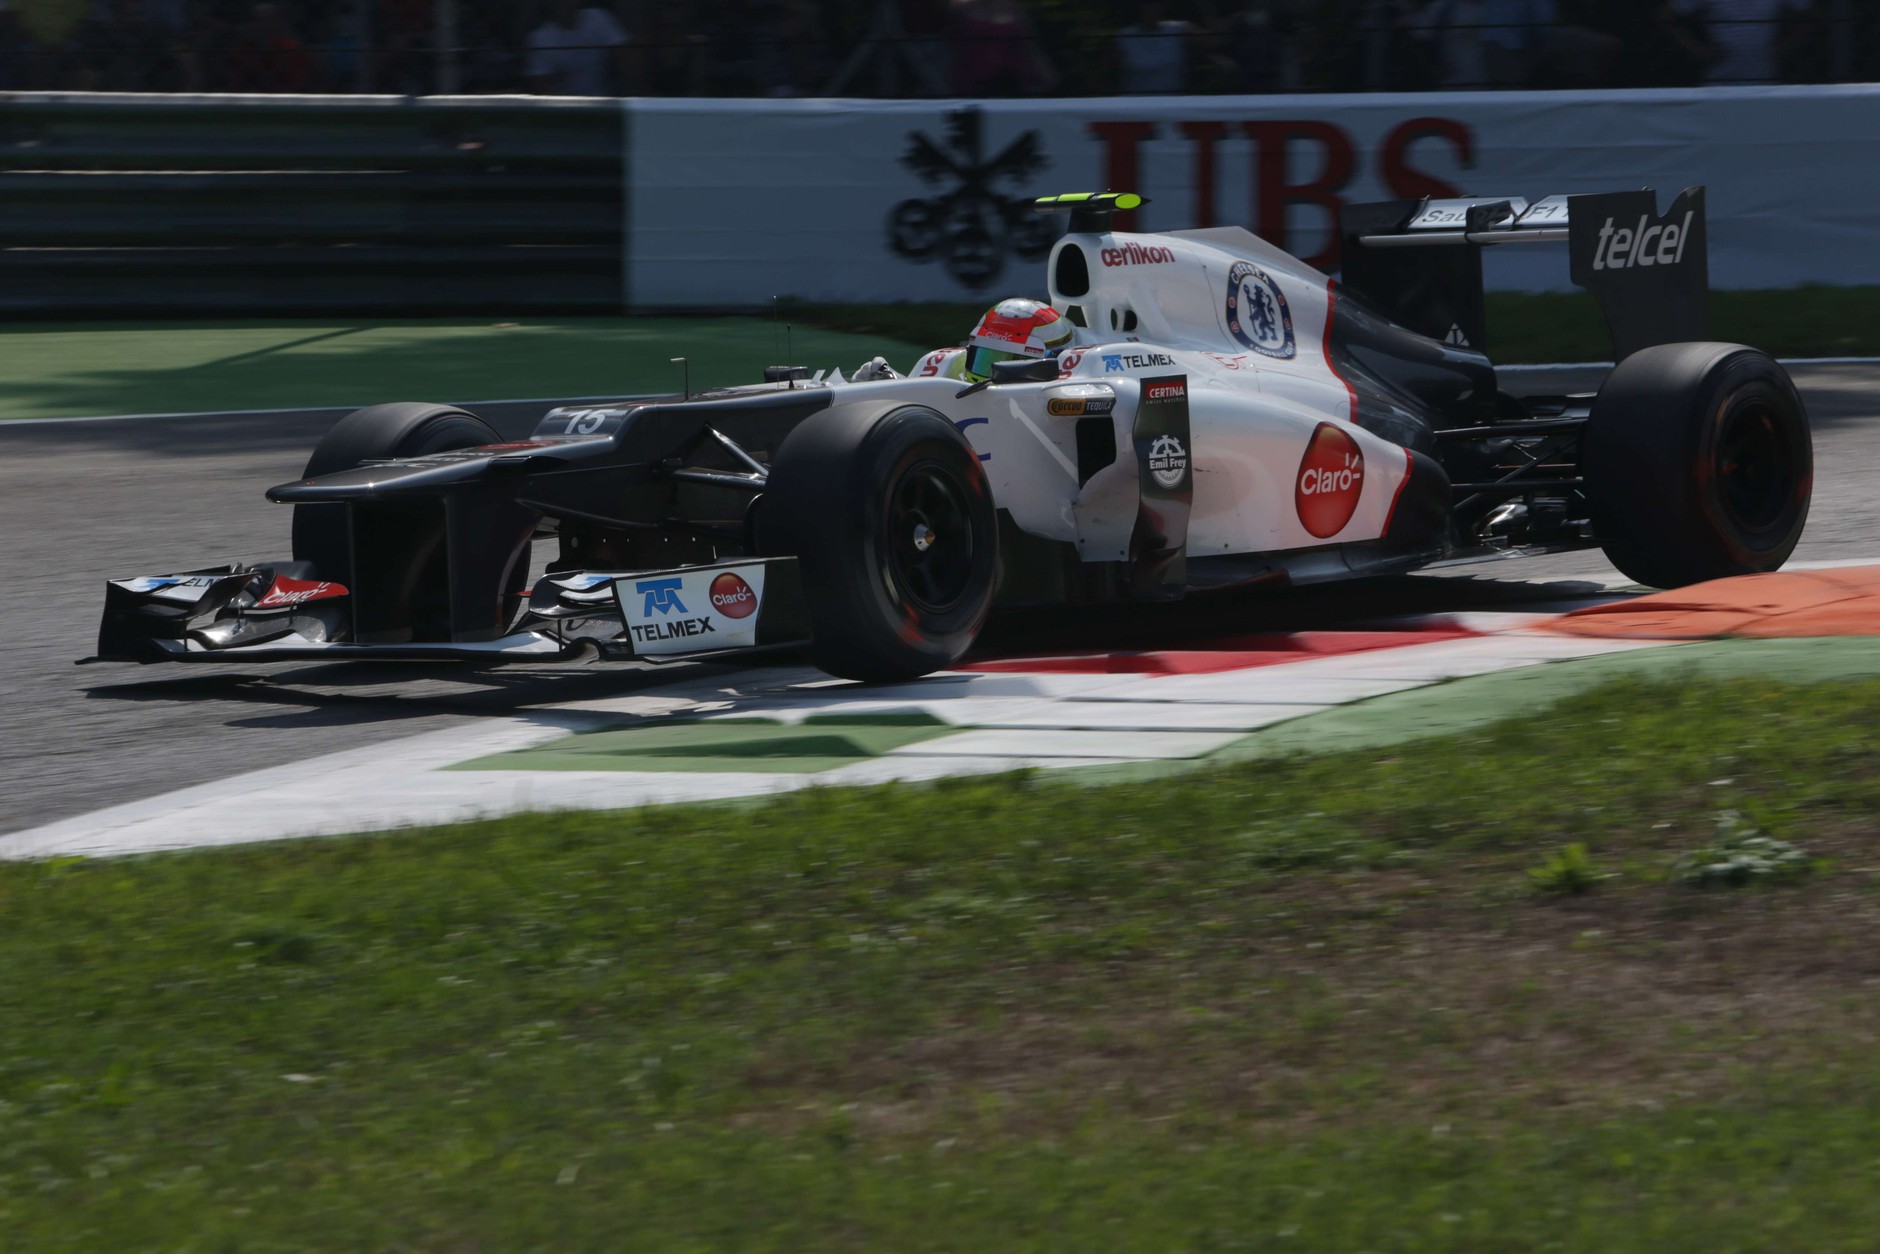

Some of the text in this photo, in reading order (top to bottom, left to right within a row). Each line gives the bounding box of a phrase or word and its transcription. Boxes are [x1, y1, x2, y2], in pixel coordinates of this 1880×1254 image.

[1592, 210, 1694, 270] telcel
[1230, 261, 1270, 285] CHELSEA
[1123, 354, 1176, 368] TELMEX
[1149, 385, 1185, 399] CERTINA
[1086, 400, 1112, 410] TEQUILA
[563, 408, 615, 434] 15
[1149, 457, 1187, 470] Emil Frey
[1300, 464, 1357, 495] Claro
[263, 586, 324, 604] Claro
[712, 586, 752, 606] Claro
[631, 617, 716, 642] TELMEX
